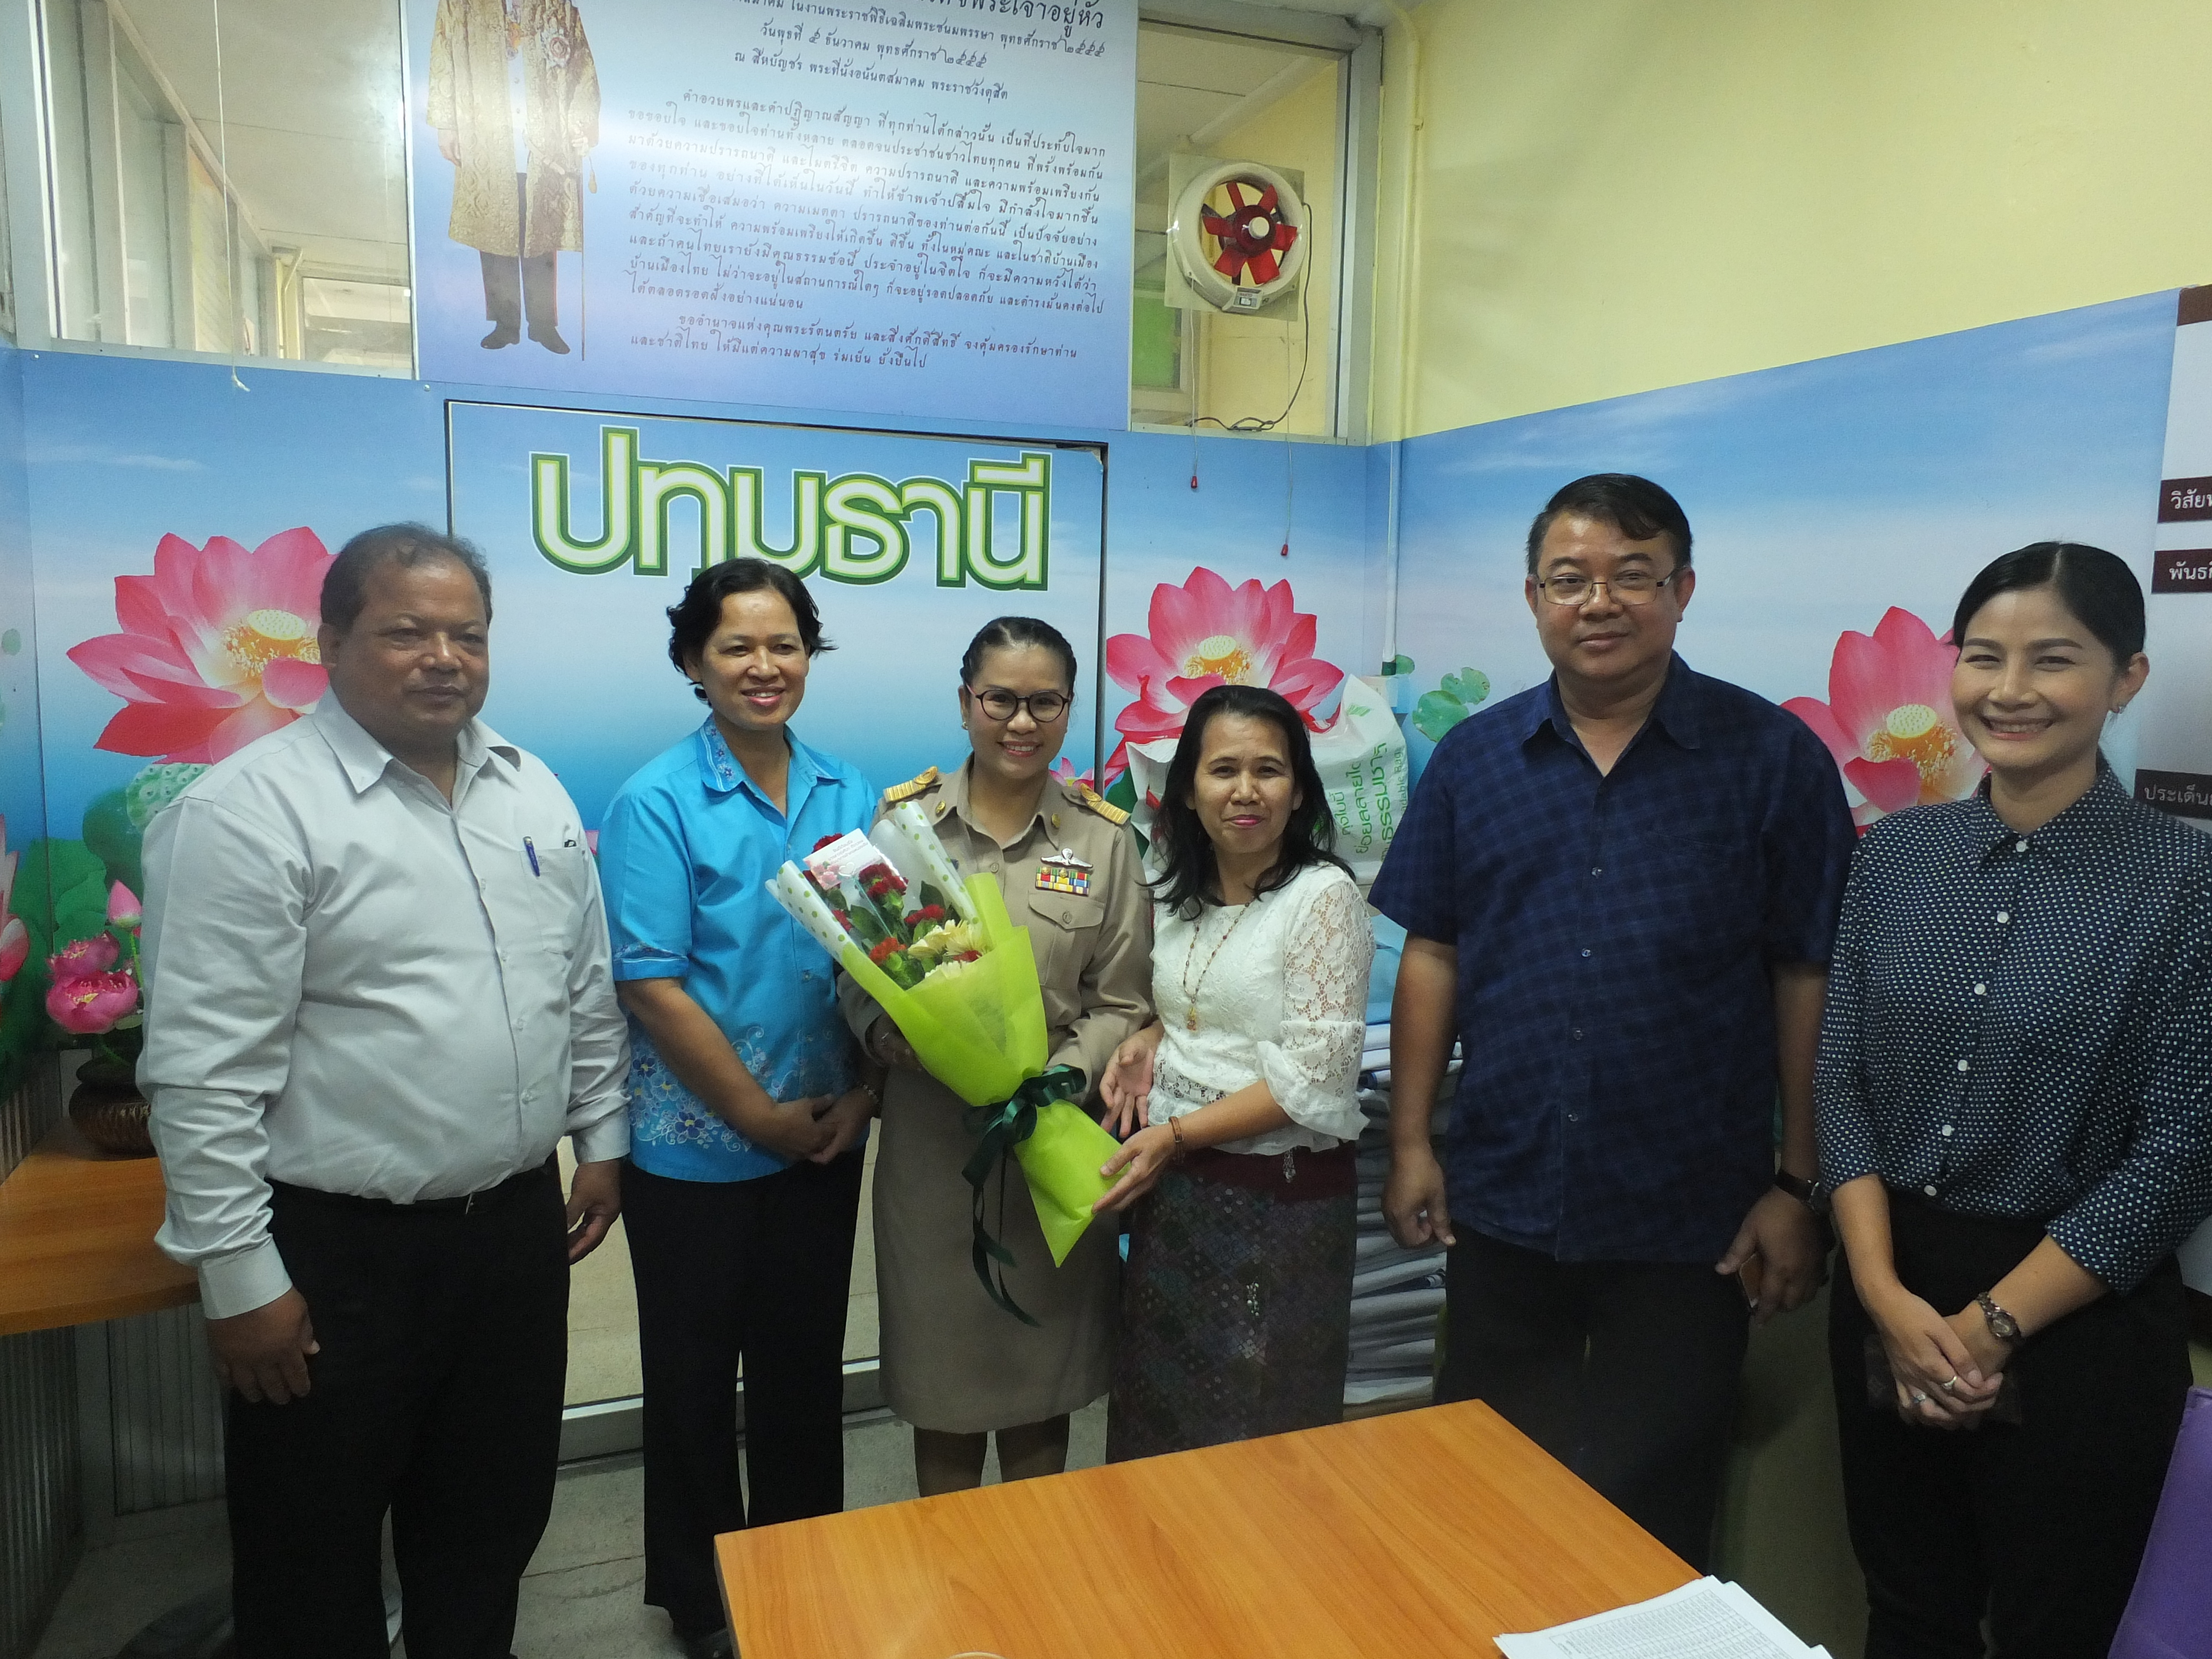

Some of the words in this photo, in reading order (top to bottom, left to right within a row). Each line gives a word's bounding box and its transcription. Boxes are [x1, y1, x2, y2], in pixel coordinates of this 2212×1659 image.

[529, 424, 1052, 592] ปทมธานี
[2144, 784, 2212, 806] ประเด็น
